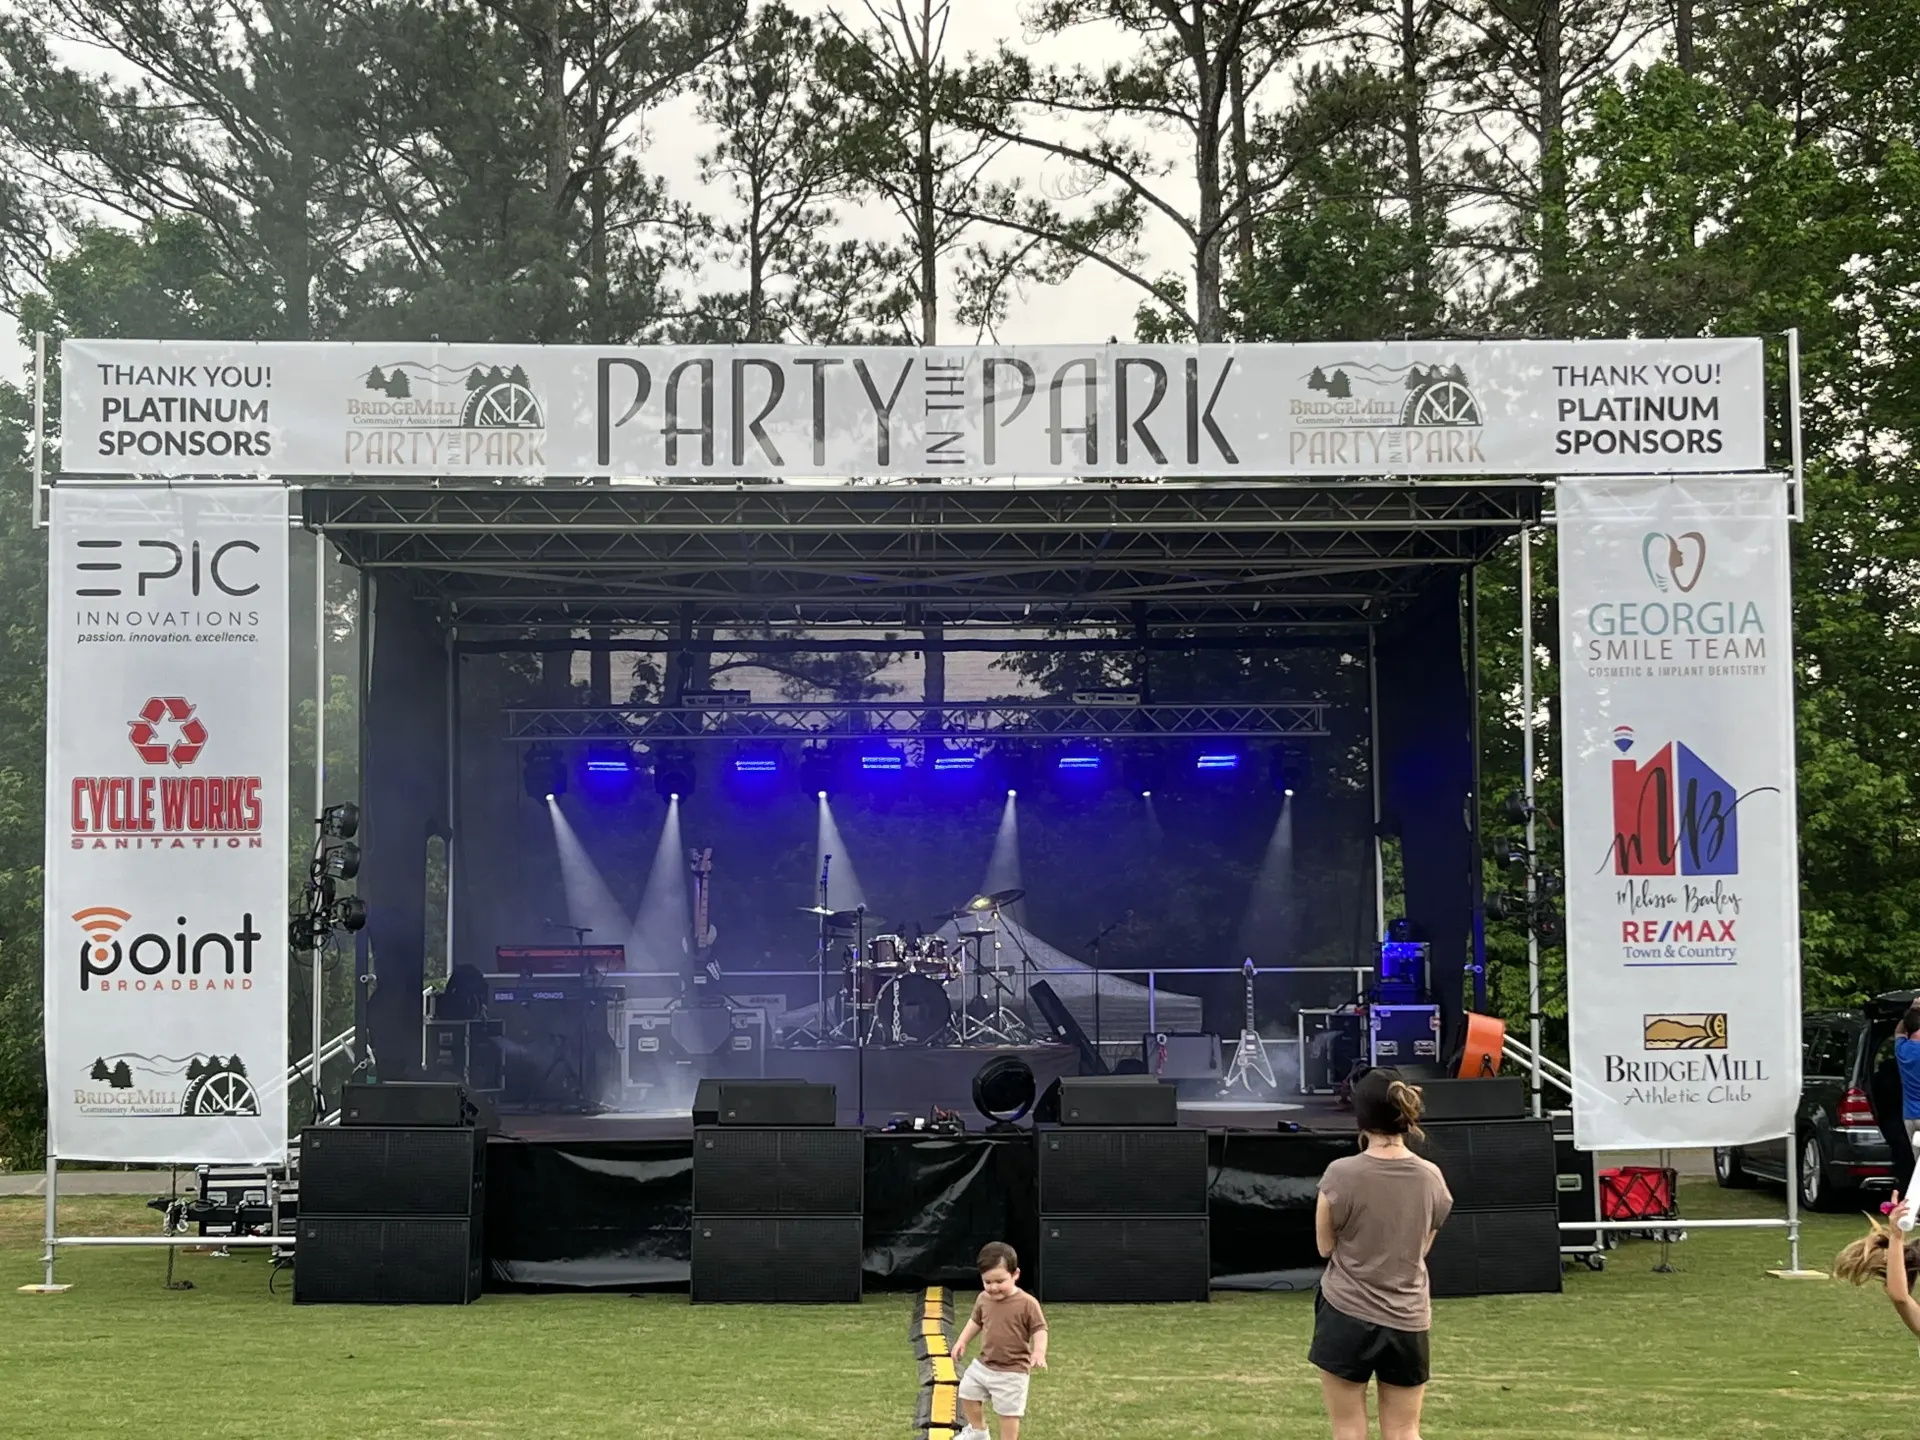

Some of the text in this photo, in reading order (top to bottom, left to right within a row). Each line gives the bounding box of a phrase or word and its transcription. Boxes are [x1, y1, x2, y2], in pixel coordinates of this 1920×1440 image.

[97, 364, 271, 388] THANK YOU!
[1552, 364, 1721, 387] THANK YOU!
[102, 397, 269, 423] PLATINUM
[353, 416, 453, 426] Community Association
[596, 356, 1240, 467] PARTY IN THE PARK
[1295, 416, 1393, 426] Community Association
[1557, 396, 1719, 422] PLATINUM
[98, 430, 272, 456] SPONSORS
[345, 430, 446, 465] PARTY
[465, 431, 546, 466] PARK
[1289, 430, 1386, 465] PARTY
[1405, 429, 1486, 464] PARK
[1555, 428, 1723, 455] SPONSORS
[76, 540, 261, 597] EPIC
[76, 611, 260, 626] INNOVATIONS
[1588, 601, 1765, 636] GEORGIA
[77, 631, 259, 644] passion. innovation. excellence.
[1588, 637, 1767, 661] SMILE TEAM
[1588, 665, 1767, 678] COSMETIC & IMPLANT DENTISTRY
[71, 776, 263, 832] CYCLE WORKS
[71, 837, 263, 849] SANITATION
[1616, 879, 1742, 915] Melissa Bailey
[1622, 919, 1737, 943] RE/MAX
[80, 912, 262, 991] point
[1622, 944, 1737, 961] Town & Country
[100, 978, 254, 991] BROADBAND
[1623, 1084, 1752, 1106] Athletic Club
[80, 1105, 174, 1116] Community Association
